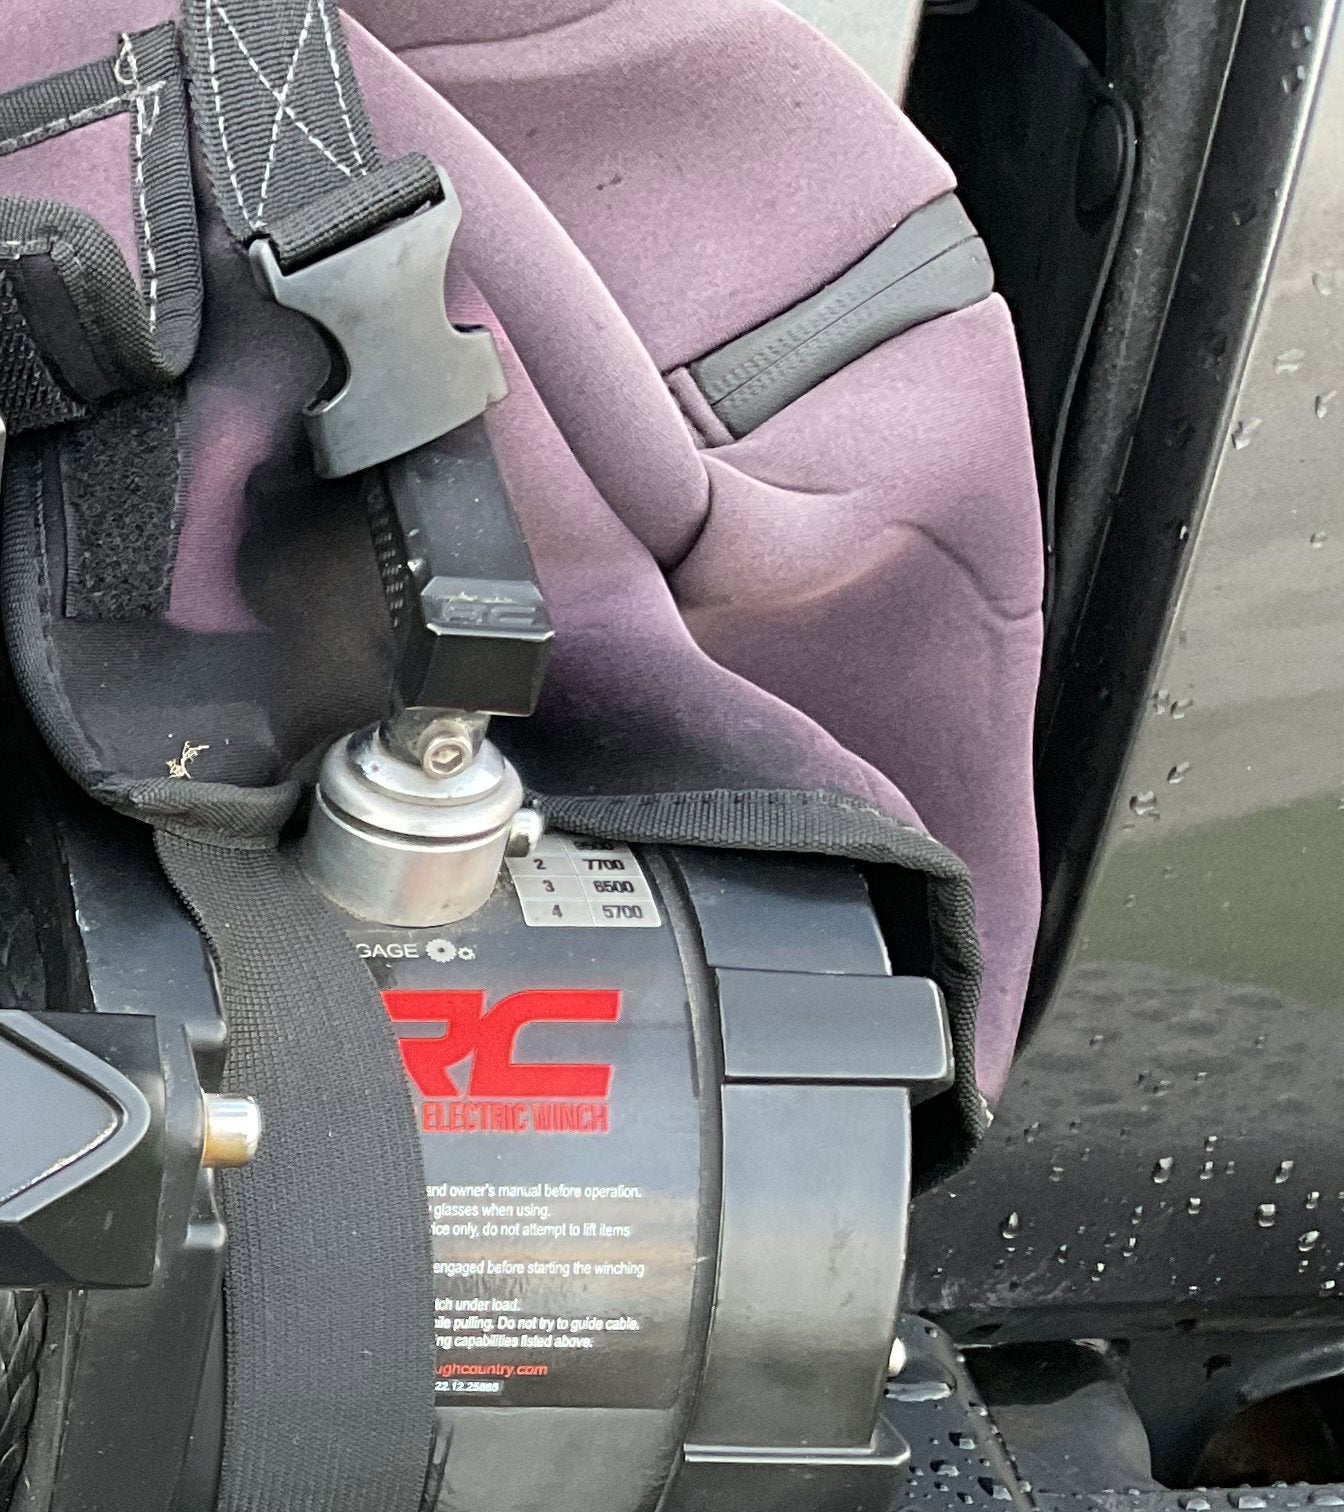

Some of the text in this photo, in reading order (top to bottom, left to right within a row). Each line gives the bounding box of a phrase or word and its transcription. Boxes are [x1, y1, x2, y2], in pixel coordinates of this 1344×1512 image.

[533, 859, 625, 870] 2 7700
[542, 880, 634, 893] 3 6500
[552, 904, 644, 919] 4 5700
[380, 989, 622, 1097] RC
[421, 1101, 610, 1135] ELECTRIC WINCH
[449, 1183, 496, 1198] owner's
[498, 1183, 542, 1198] manual
[544, 1184, 582, 1198] before
[584, 1184, 642, 1201] operation.
[433, 1203, 552, 1220] glasses when using.
[452, 1222, 480, 1239] only,
[482, 1222, 497, 1236] do
[500, 1222, 520, 1236] not
[522, 1223, 567, 1239] attempt
[569, 1223, 581, 1237] to
[583, 1222, 597, 1237] lift
[599, 1223, 631, 1237] items
[432, 1260, 646, 1279] engaged before starting the winching
[455, 1298, 490, 1312] under
[492, 1298, 521, 1312] load.
[453, 1316, 495, 1333] pulling.
[497, 1315, 516, 1330] Do
[517, 1316, 537, 1330] not
[538, 1316, 556, 1333] try
[557, 1317, 569, 1330] to
[570, 1316, 605, 1333] guide
[605, 1316, 641, 1331] cable.
[454, 1334, 519, 1350] capabilities
[520, 1334, 553, 1348] listed
[553, 1334, 593, 1349] above.
